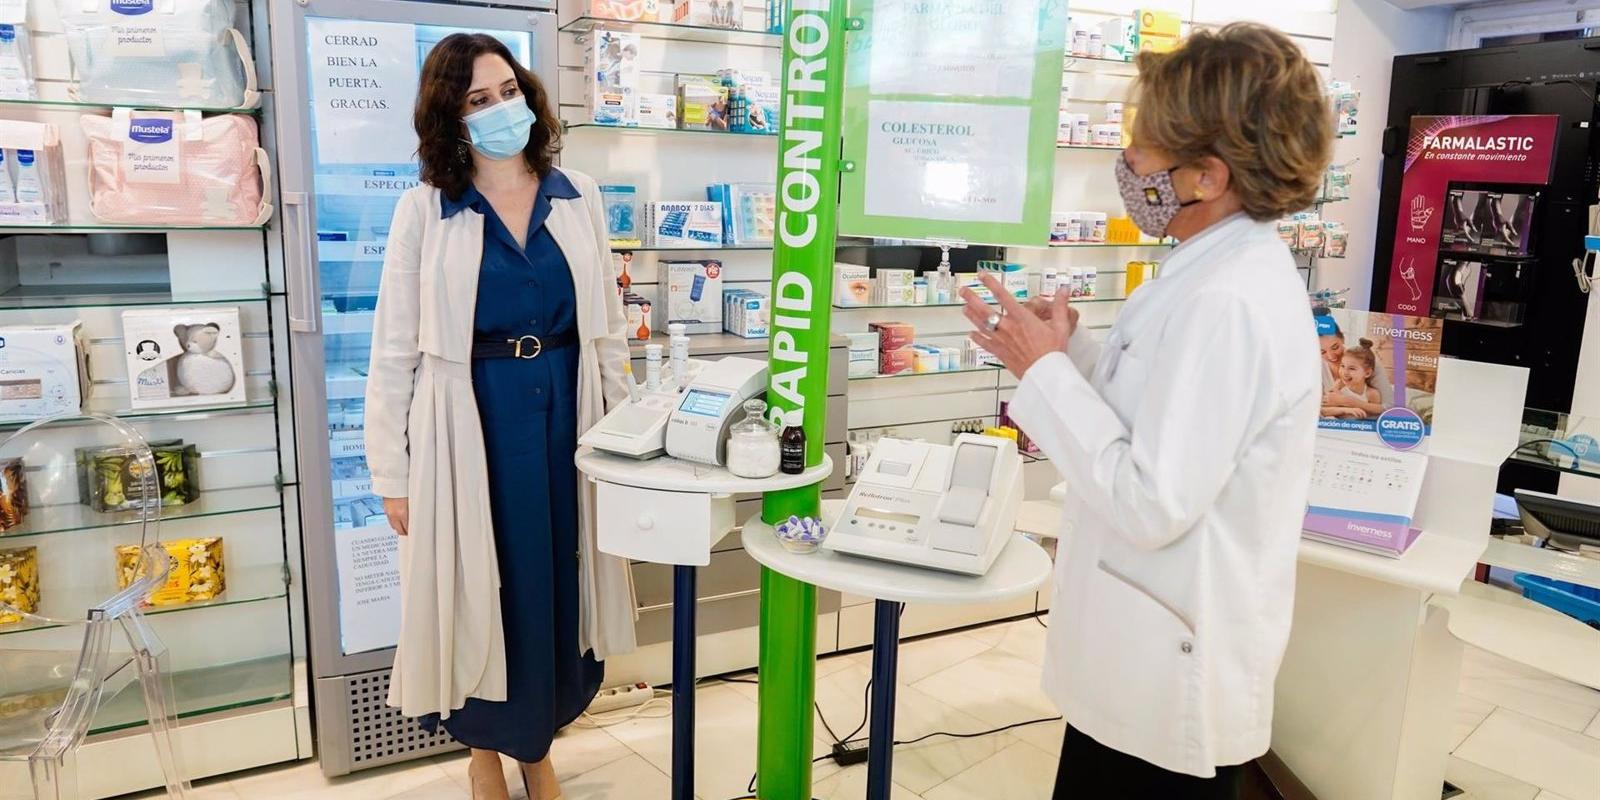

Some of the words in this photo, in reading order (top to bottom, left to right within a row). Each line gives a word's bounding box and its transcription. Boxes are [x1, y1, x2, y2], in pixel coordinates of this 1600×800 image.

[325, 35, 378, 46] CERRAD
[327, 56, 357, 66] BIEN
[361, 57, 377, 67] LA
[329, 77, 382, 89] PUERTA.
[330, 98, 390, 109] GRACIAS.
[881, 121, 975, 137] COLESTEROL
[892, 137, 937, 147] GLUCOSA
[1423, 136, 1534, 151] FARMALASTIC
[1424, 152, 1435, 160] En
[1436, 152, 1476, 161] constante
[1477, 153, 1527, 162] movimiento
[1398, 303, 1417, 311] CODO
[1373, 323, 1433, 342] inverness
[1381, 419, 1420, 431] GRATIS
[1347, 521, 1393, 539] inverness
